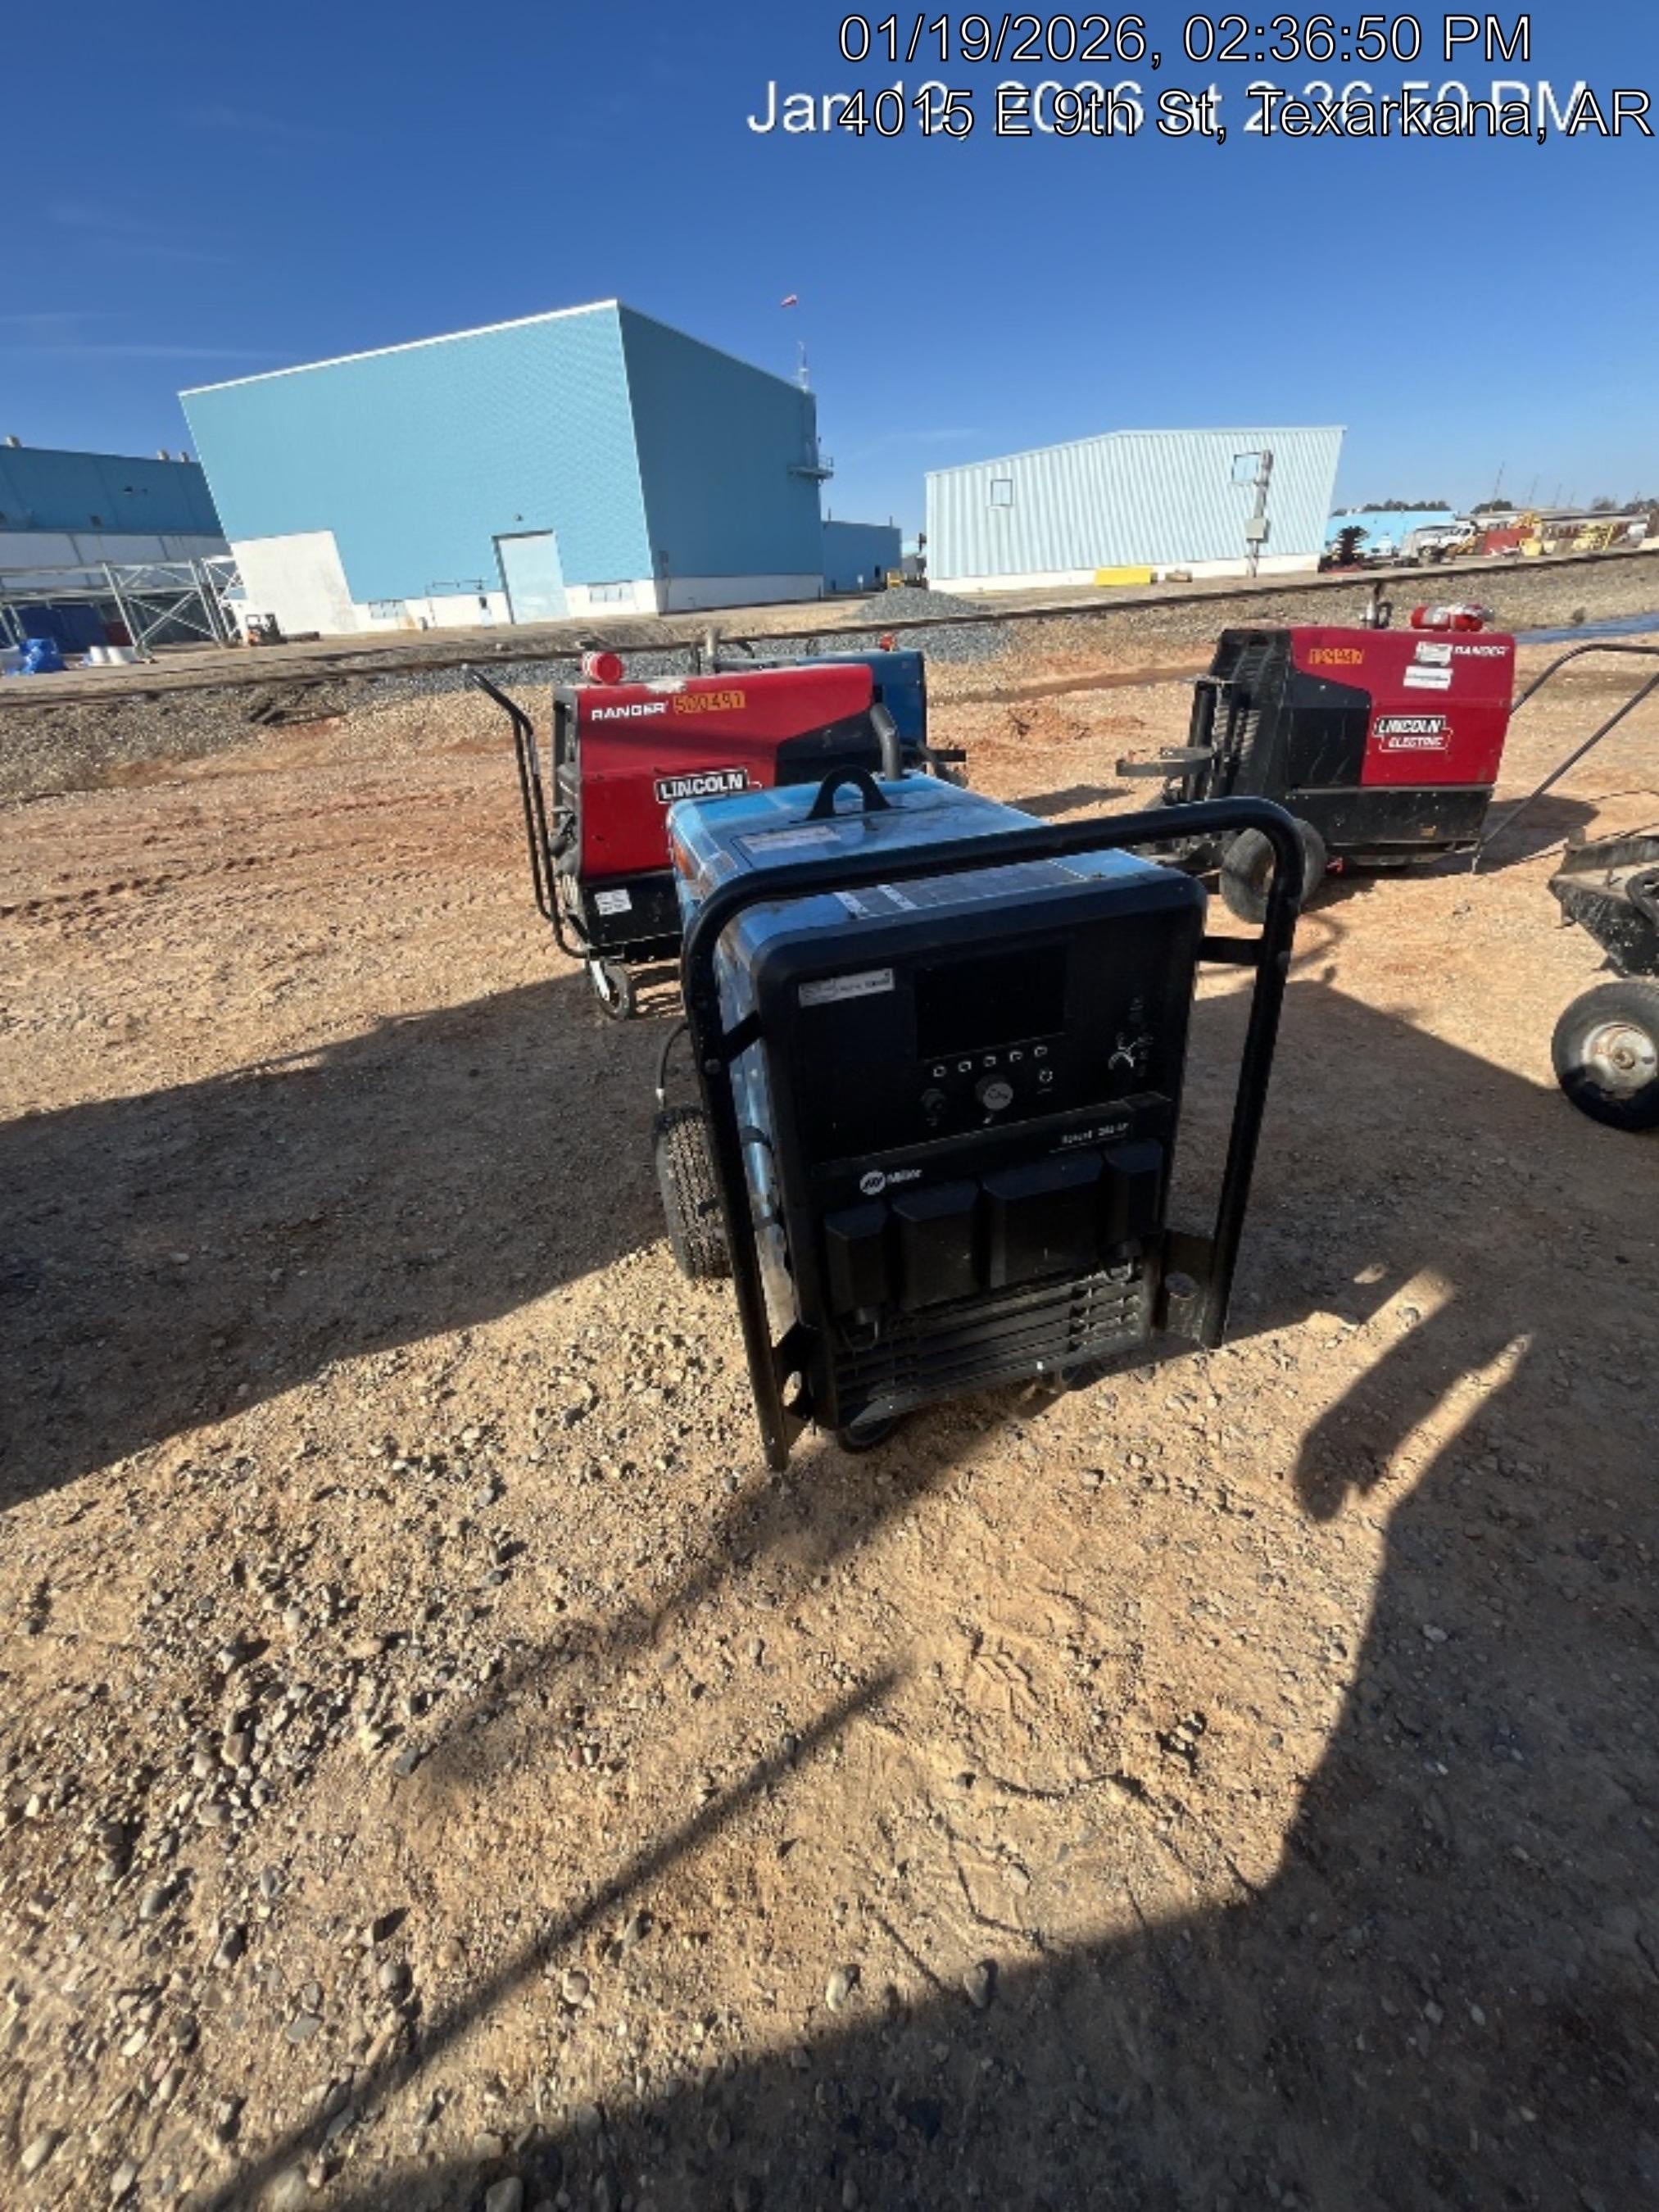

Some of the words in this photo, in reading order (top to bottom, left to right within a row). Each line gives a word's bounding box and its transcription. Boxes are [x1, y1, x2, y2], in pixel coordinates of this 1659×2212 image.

[592, 702, 665, 721] RANGER
[1378, 718, 1442, 734] LINCOLN
[660, 773, 743, 799] LINCOLN
